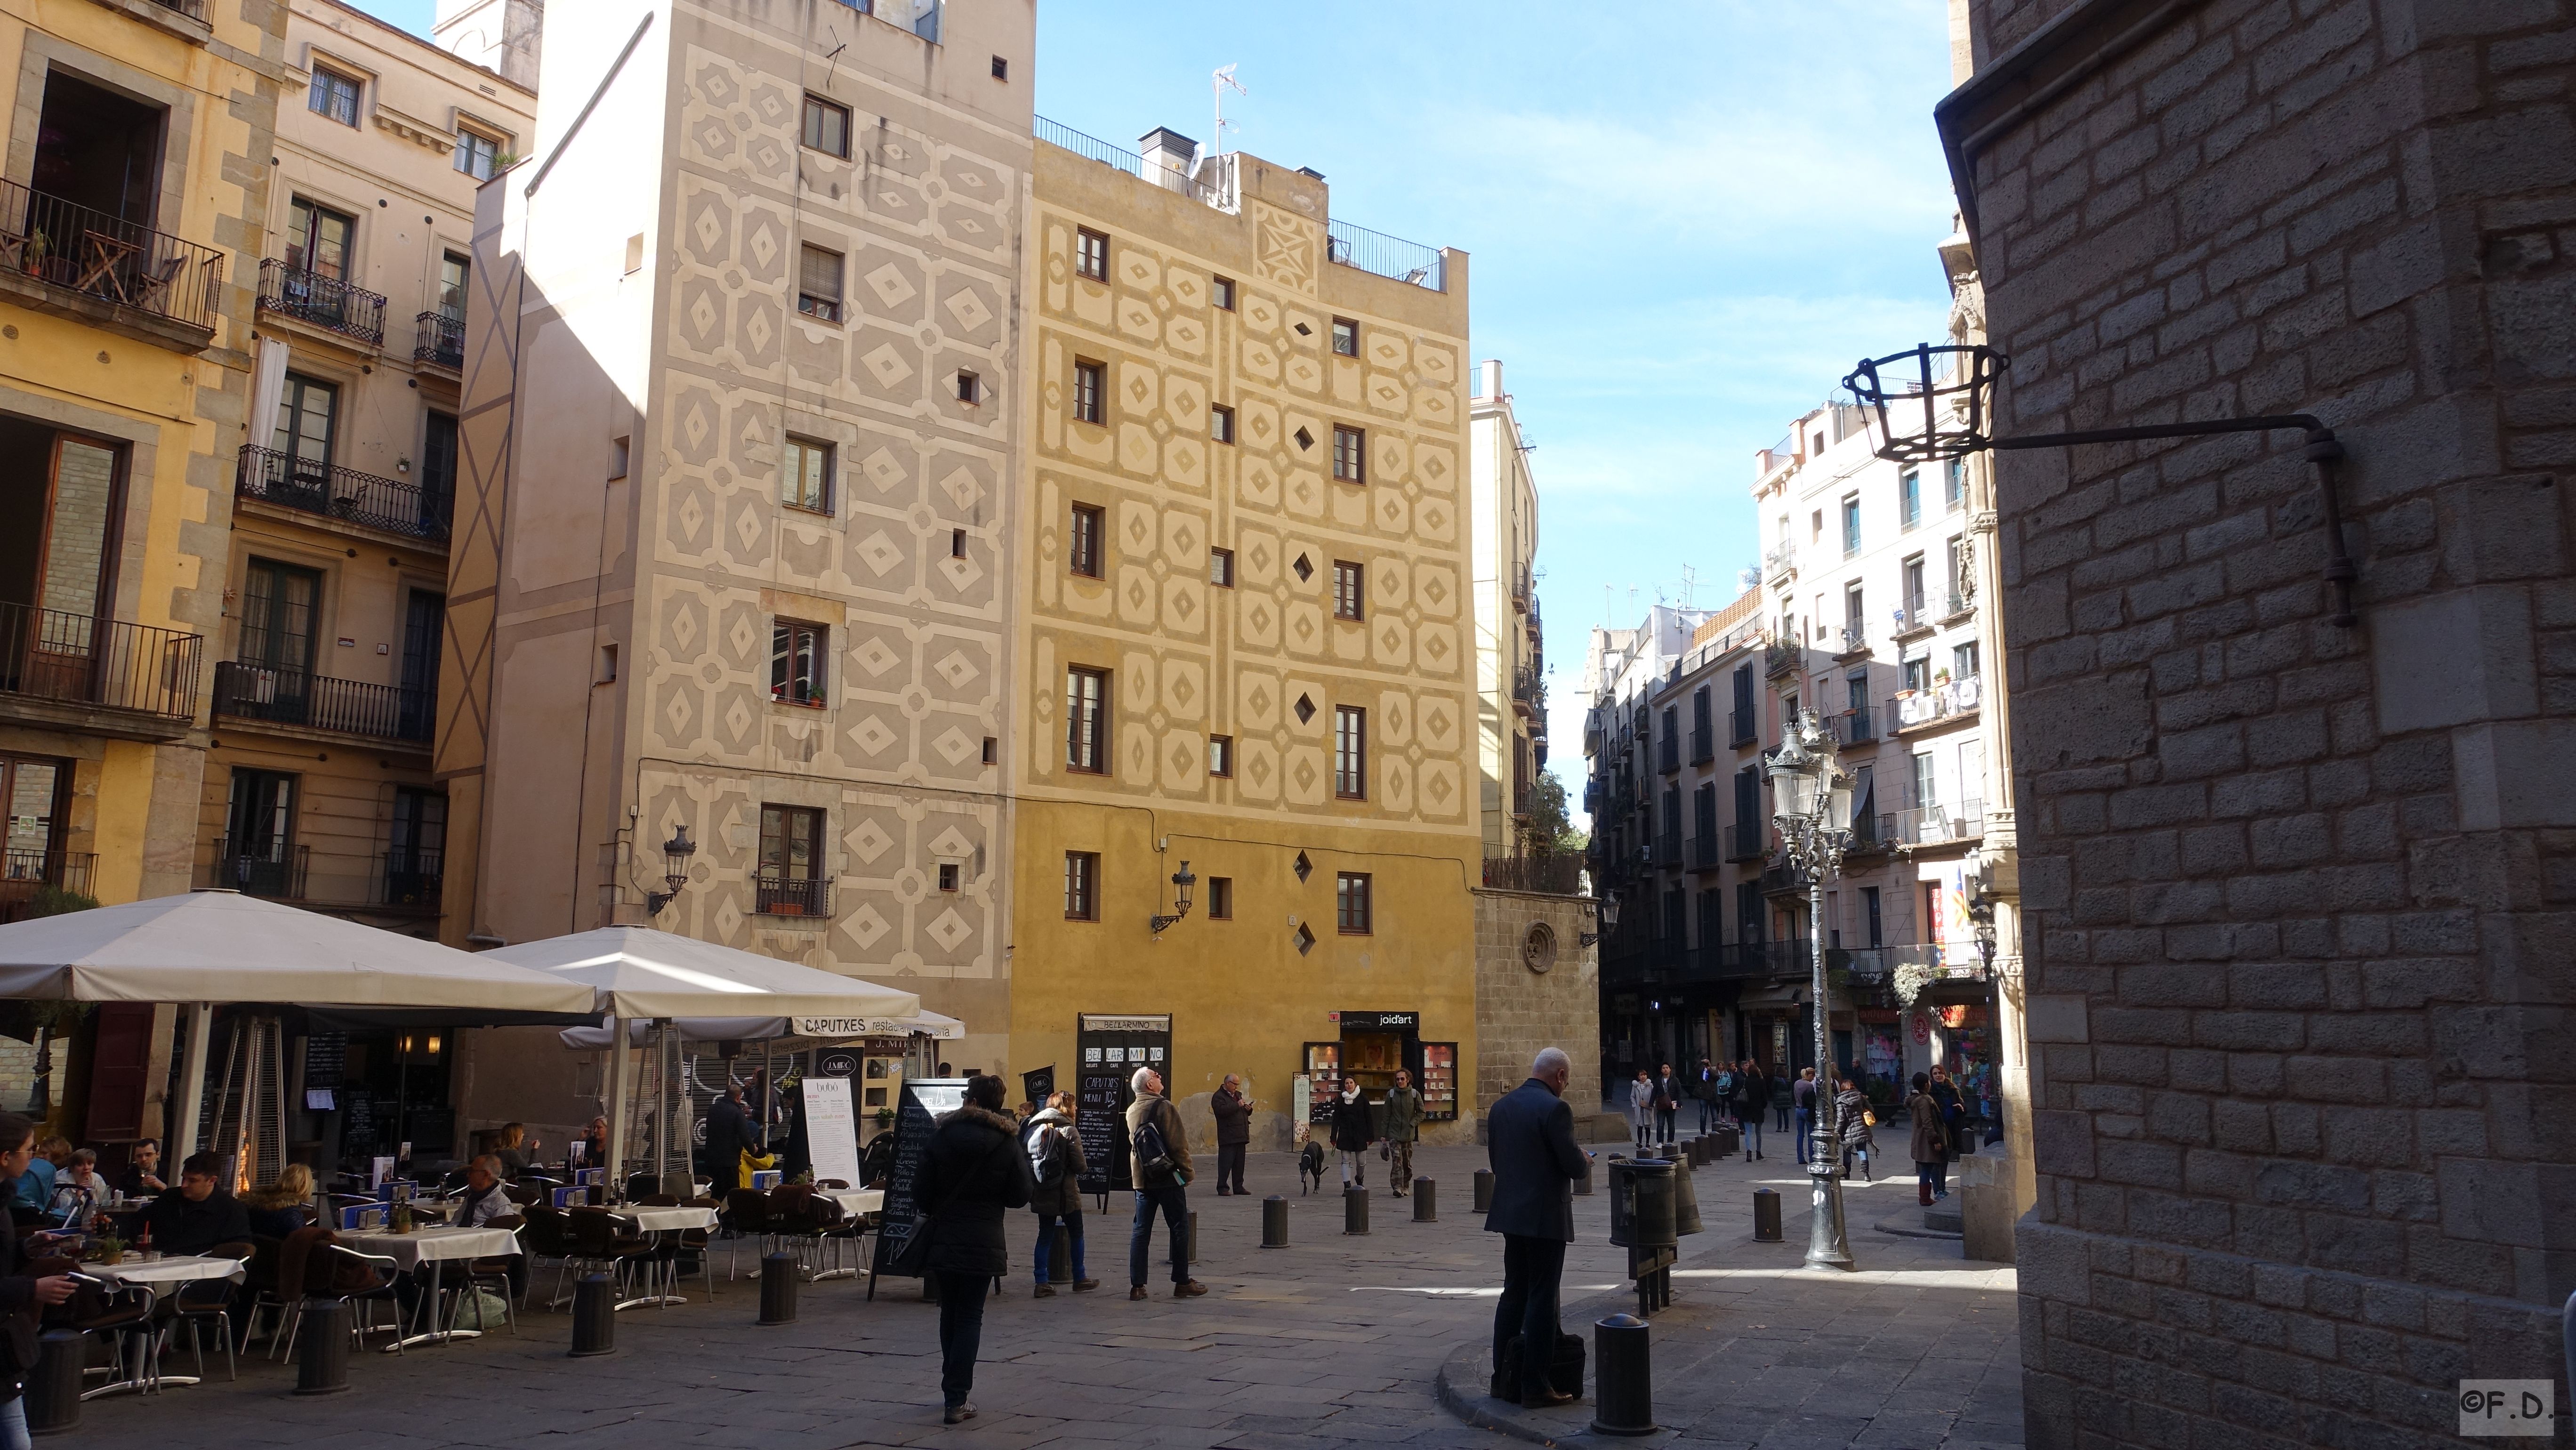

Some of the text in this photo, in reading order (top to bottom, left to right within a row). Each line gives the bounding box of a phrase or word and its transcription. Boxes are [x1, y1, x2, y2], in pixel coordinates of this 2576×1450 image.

[805, 1019, 865, 1032] CAPUTXES
[1379, 1015, 1412, 1026] joid'art
[1087, 1049, 1101, 1060] BEL
[1106, 1049, 1123, 1060] LAR
[1150, 1049, 1162, 1059] NO
[817, 1082, 838, 1092] bubó
[1084, 1094, 1101, 1102] MENU
